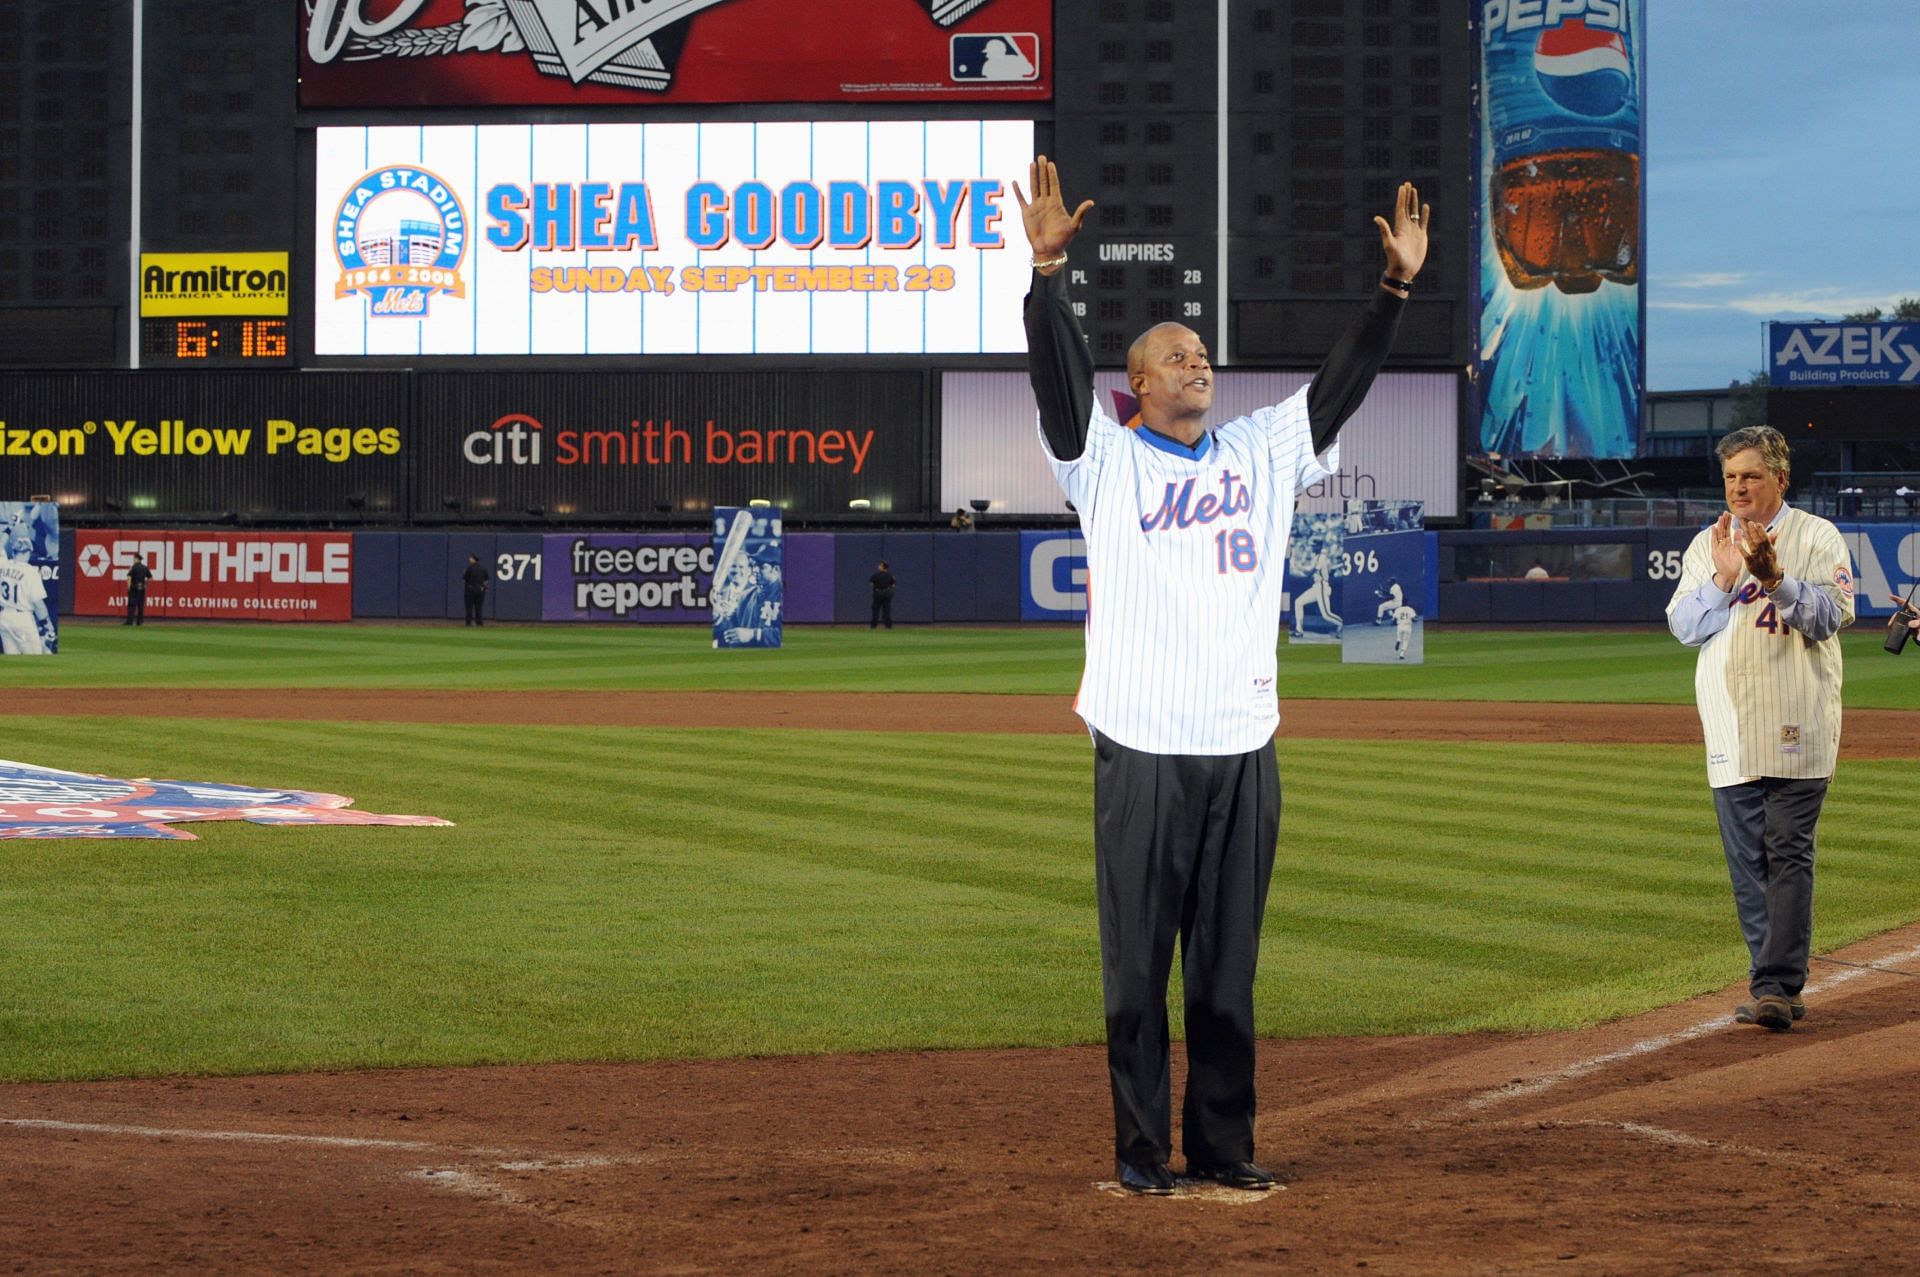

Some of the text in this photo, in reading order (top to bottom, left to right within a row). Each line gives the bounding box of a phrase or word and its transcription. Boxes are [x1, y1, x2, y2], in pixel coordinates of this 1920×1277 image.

[338, 170, 463, 256] SHEA STADIUM
[485, 179, 1004, 251] SHEA GOODBYE
[1099, 244, 1174, 261] UMPIRES
[144, 265, 286, 292] Armitron
[345, 269, 454, 286] 1964 2008
[530, 265, 955, 296] SUNDAY, SEPTEMBER 28
[1072, 270, 1088, 284] PL
[1183, 270, 1201, 284] 2B
[374, 287, 425, 313] Mets
[1072, 302, 1087, 317] 1B
[1183, 302, 1201, 316] 3B
[1776, 327, 1904, 365] AZEK
[1790, 369, 1890, 382] Building Products
[104, 420, 251, 456] Yellow
[267, 420, 401, 462] Pages
[463, 418, 875, 474] citi smith barney
[1140, 469, 1250, 532] Mets
[112, 540, 349, 583] SOUTHPOLE
[1215, 529, 1258, 574] 18
[1342, 549, 1379, 576] 396
[497, 554, 541, 581] 371
[1, 580, 18, 603] 31
[108, 596, 317, 610] AUTNTIC CLOTHING COLLECTION
